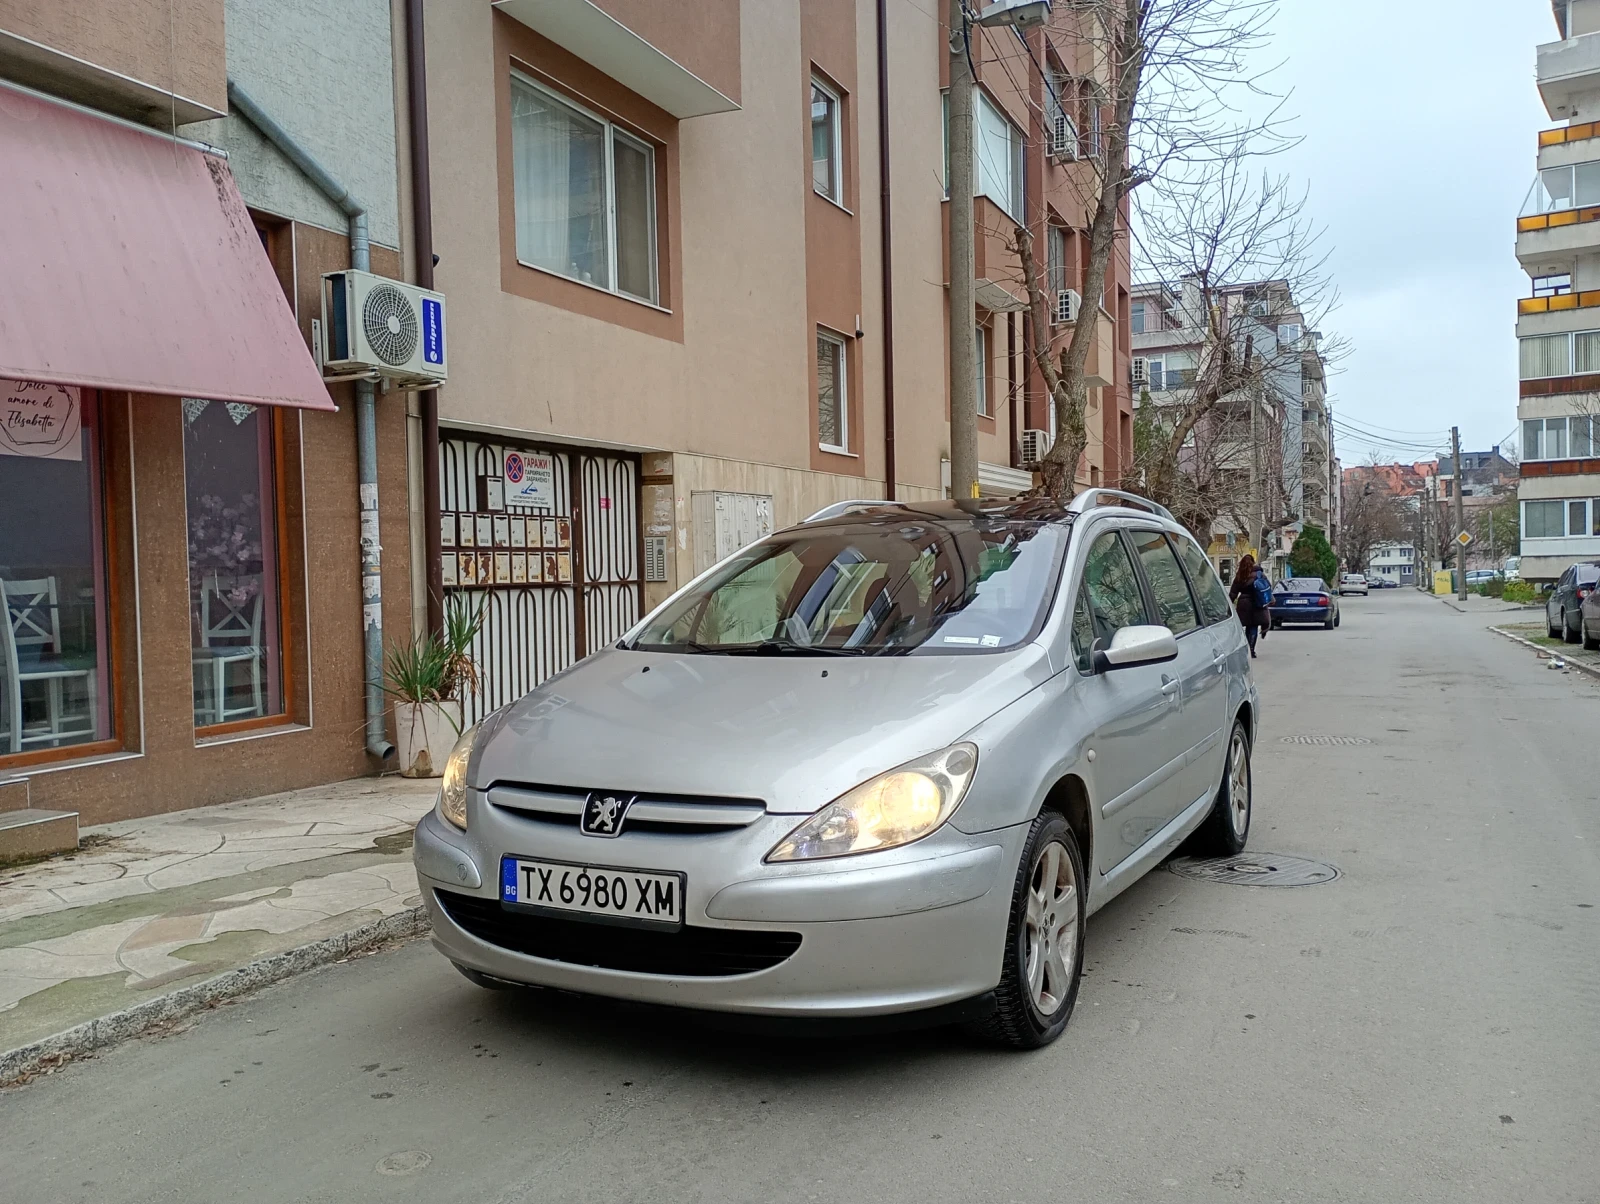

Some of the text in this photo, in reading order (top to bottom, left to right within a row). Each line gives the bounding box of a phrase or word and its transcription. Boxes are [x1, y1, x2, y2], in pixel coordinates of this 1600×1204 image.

[429, 302, 438, 350] nippon
[7, 395, 55, 409] amore di
[7, 410, 56, 433] Elisabetta
[524, 457, 548, 470] ГАРАЖИ
[505, 885, 517, 896] BG
[520, 865, 674, 916] TX 6980 XM
